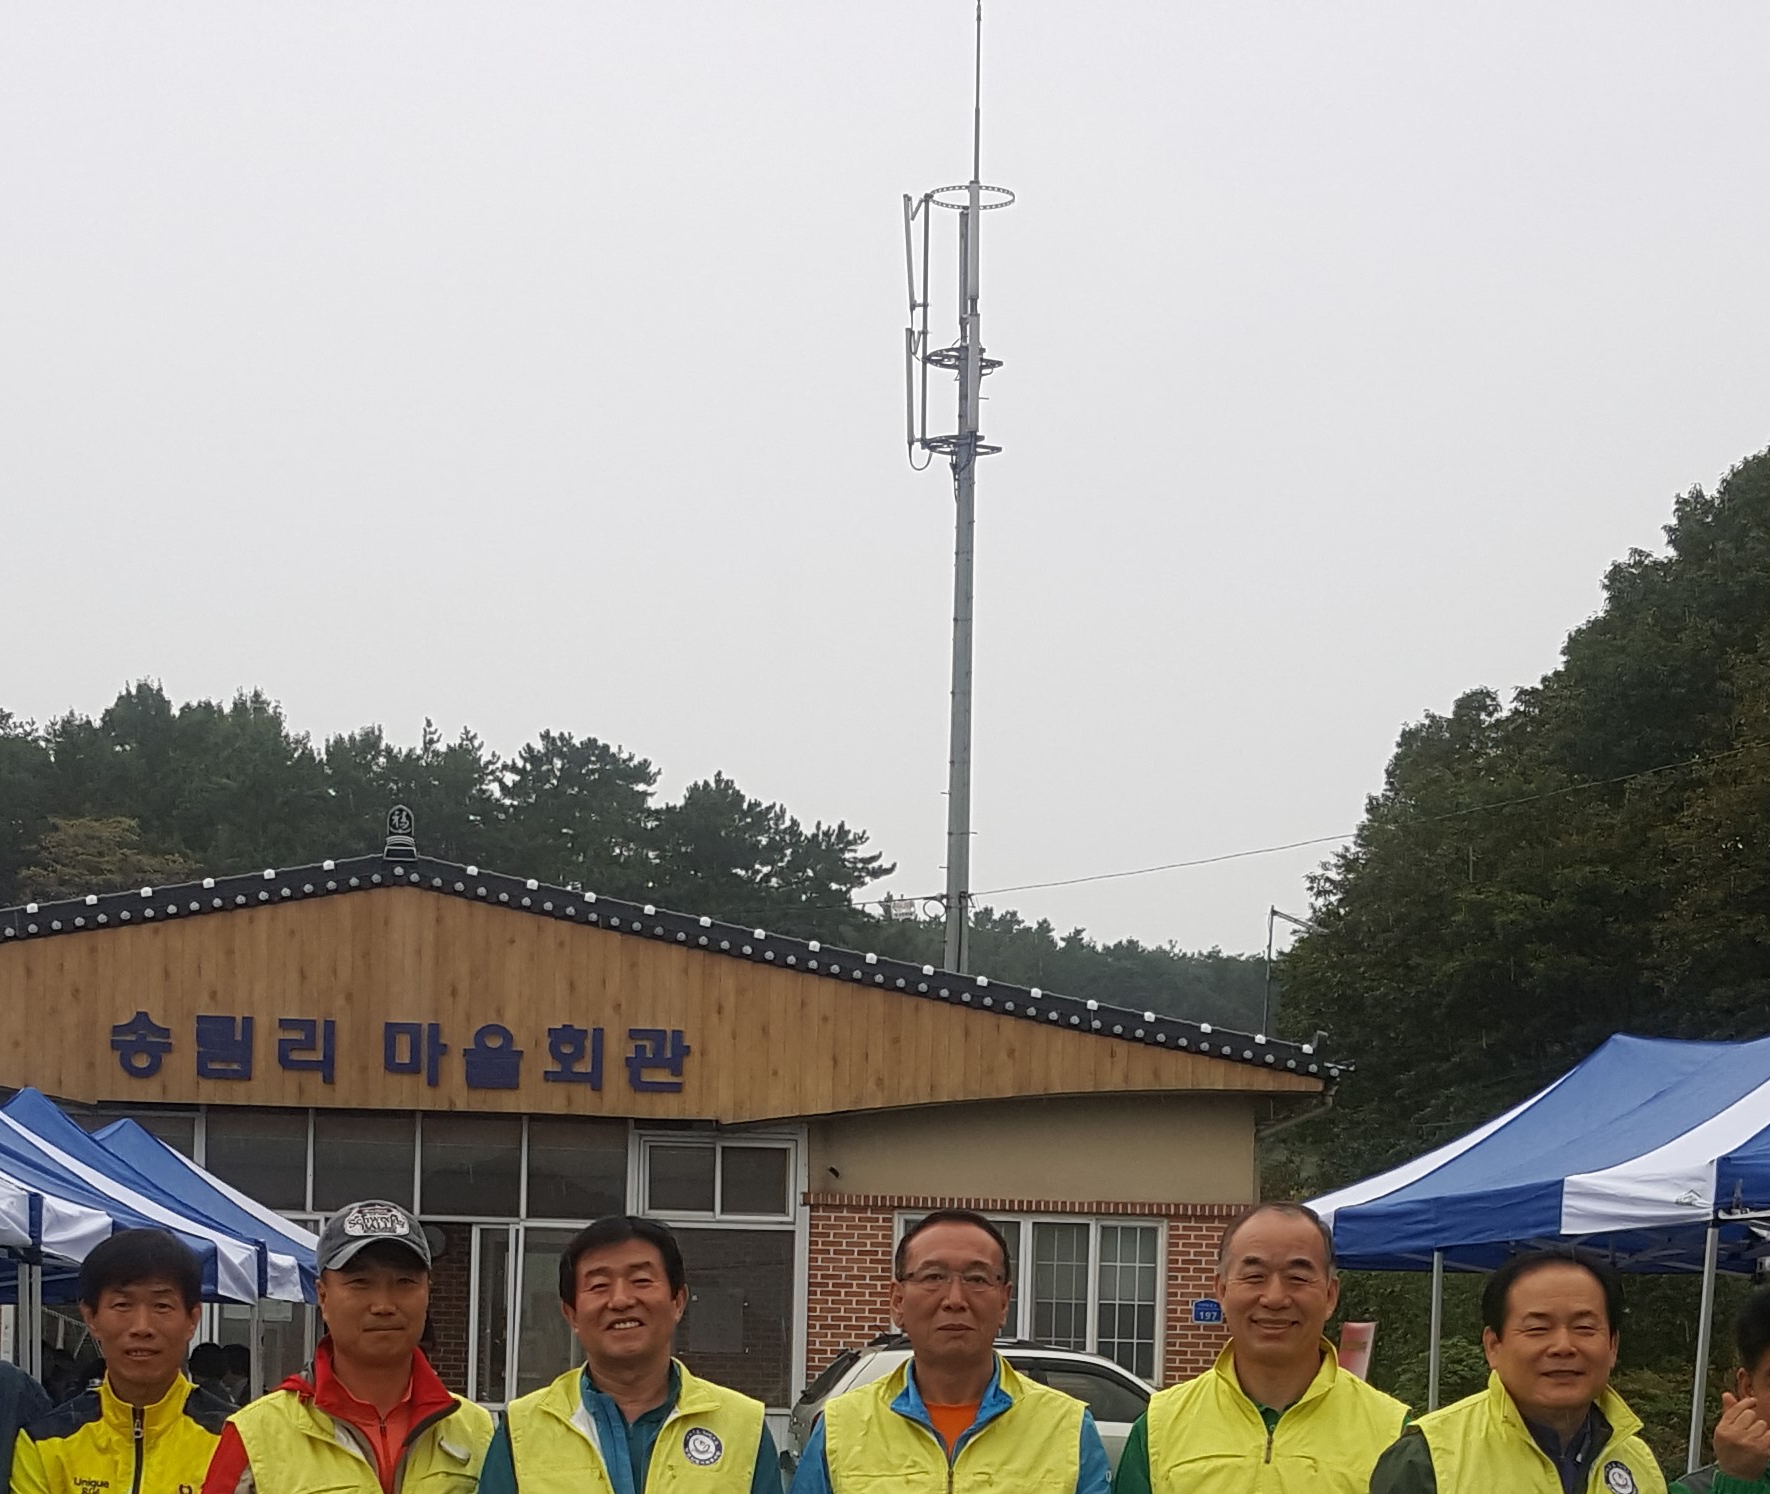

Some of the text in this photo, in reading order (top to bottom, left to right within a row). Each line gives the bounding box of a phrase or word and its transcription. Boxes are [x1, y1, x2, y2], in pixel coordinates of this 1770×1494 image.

[110, 1011, 691, 1092] 송림리 마을회관
[1199, 1311, 1218, 1321] 197
